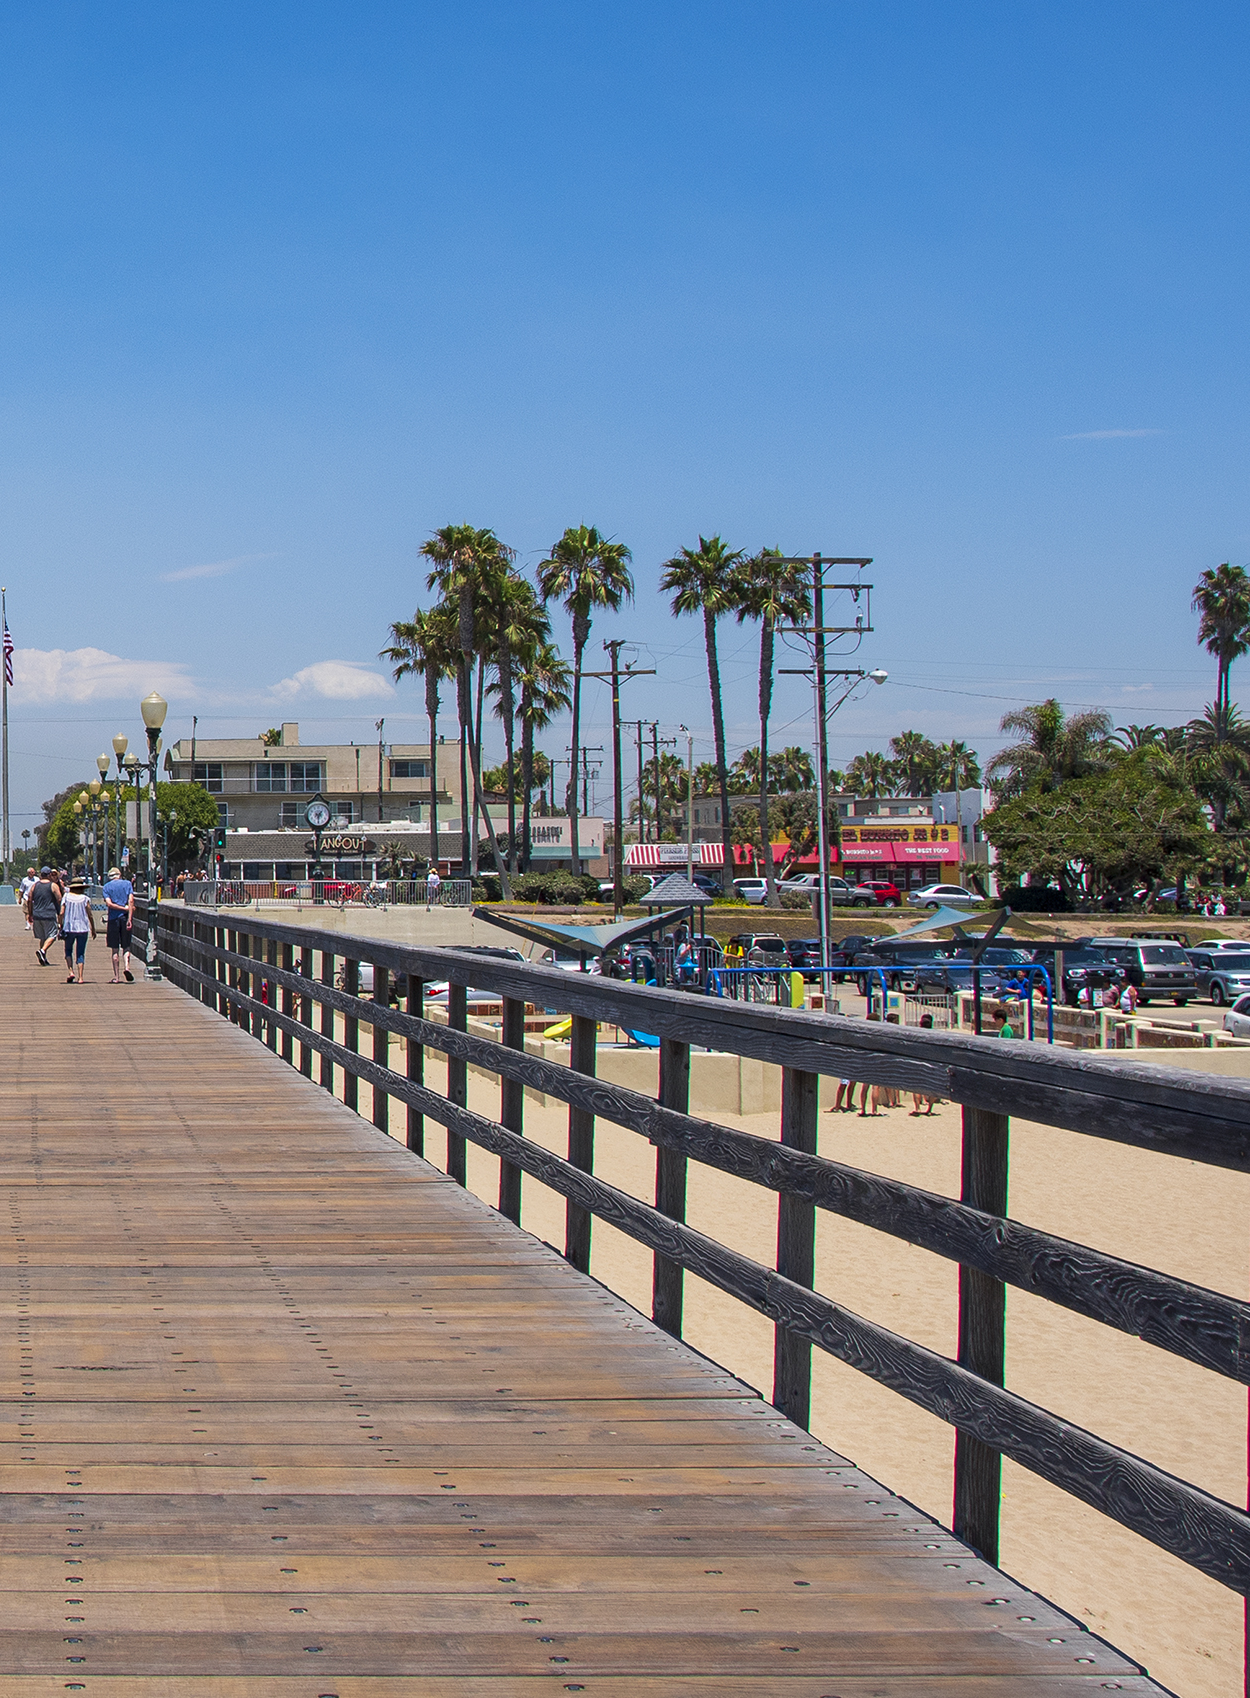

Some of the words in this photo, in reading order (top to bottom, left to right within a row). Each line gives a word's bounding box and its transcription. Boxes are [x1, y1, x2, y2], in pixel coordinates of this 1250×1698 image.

[842, 829, 857, 842] EL
[860, 829, 909, 842] BURRITO
[913, 828, 927, 842] JR
